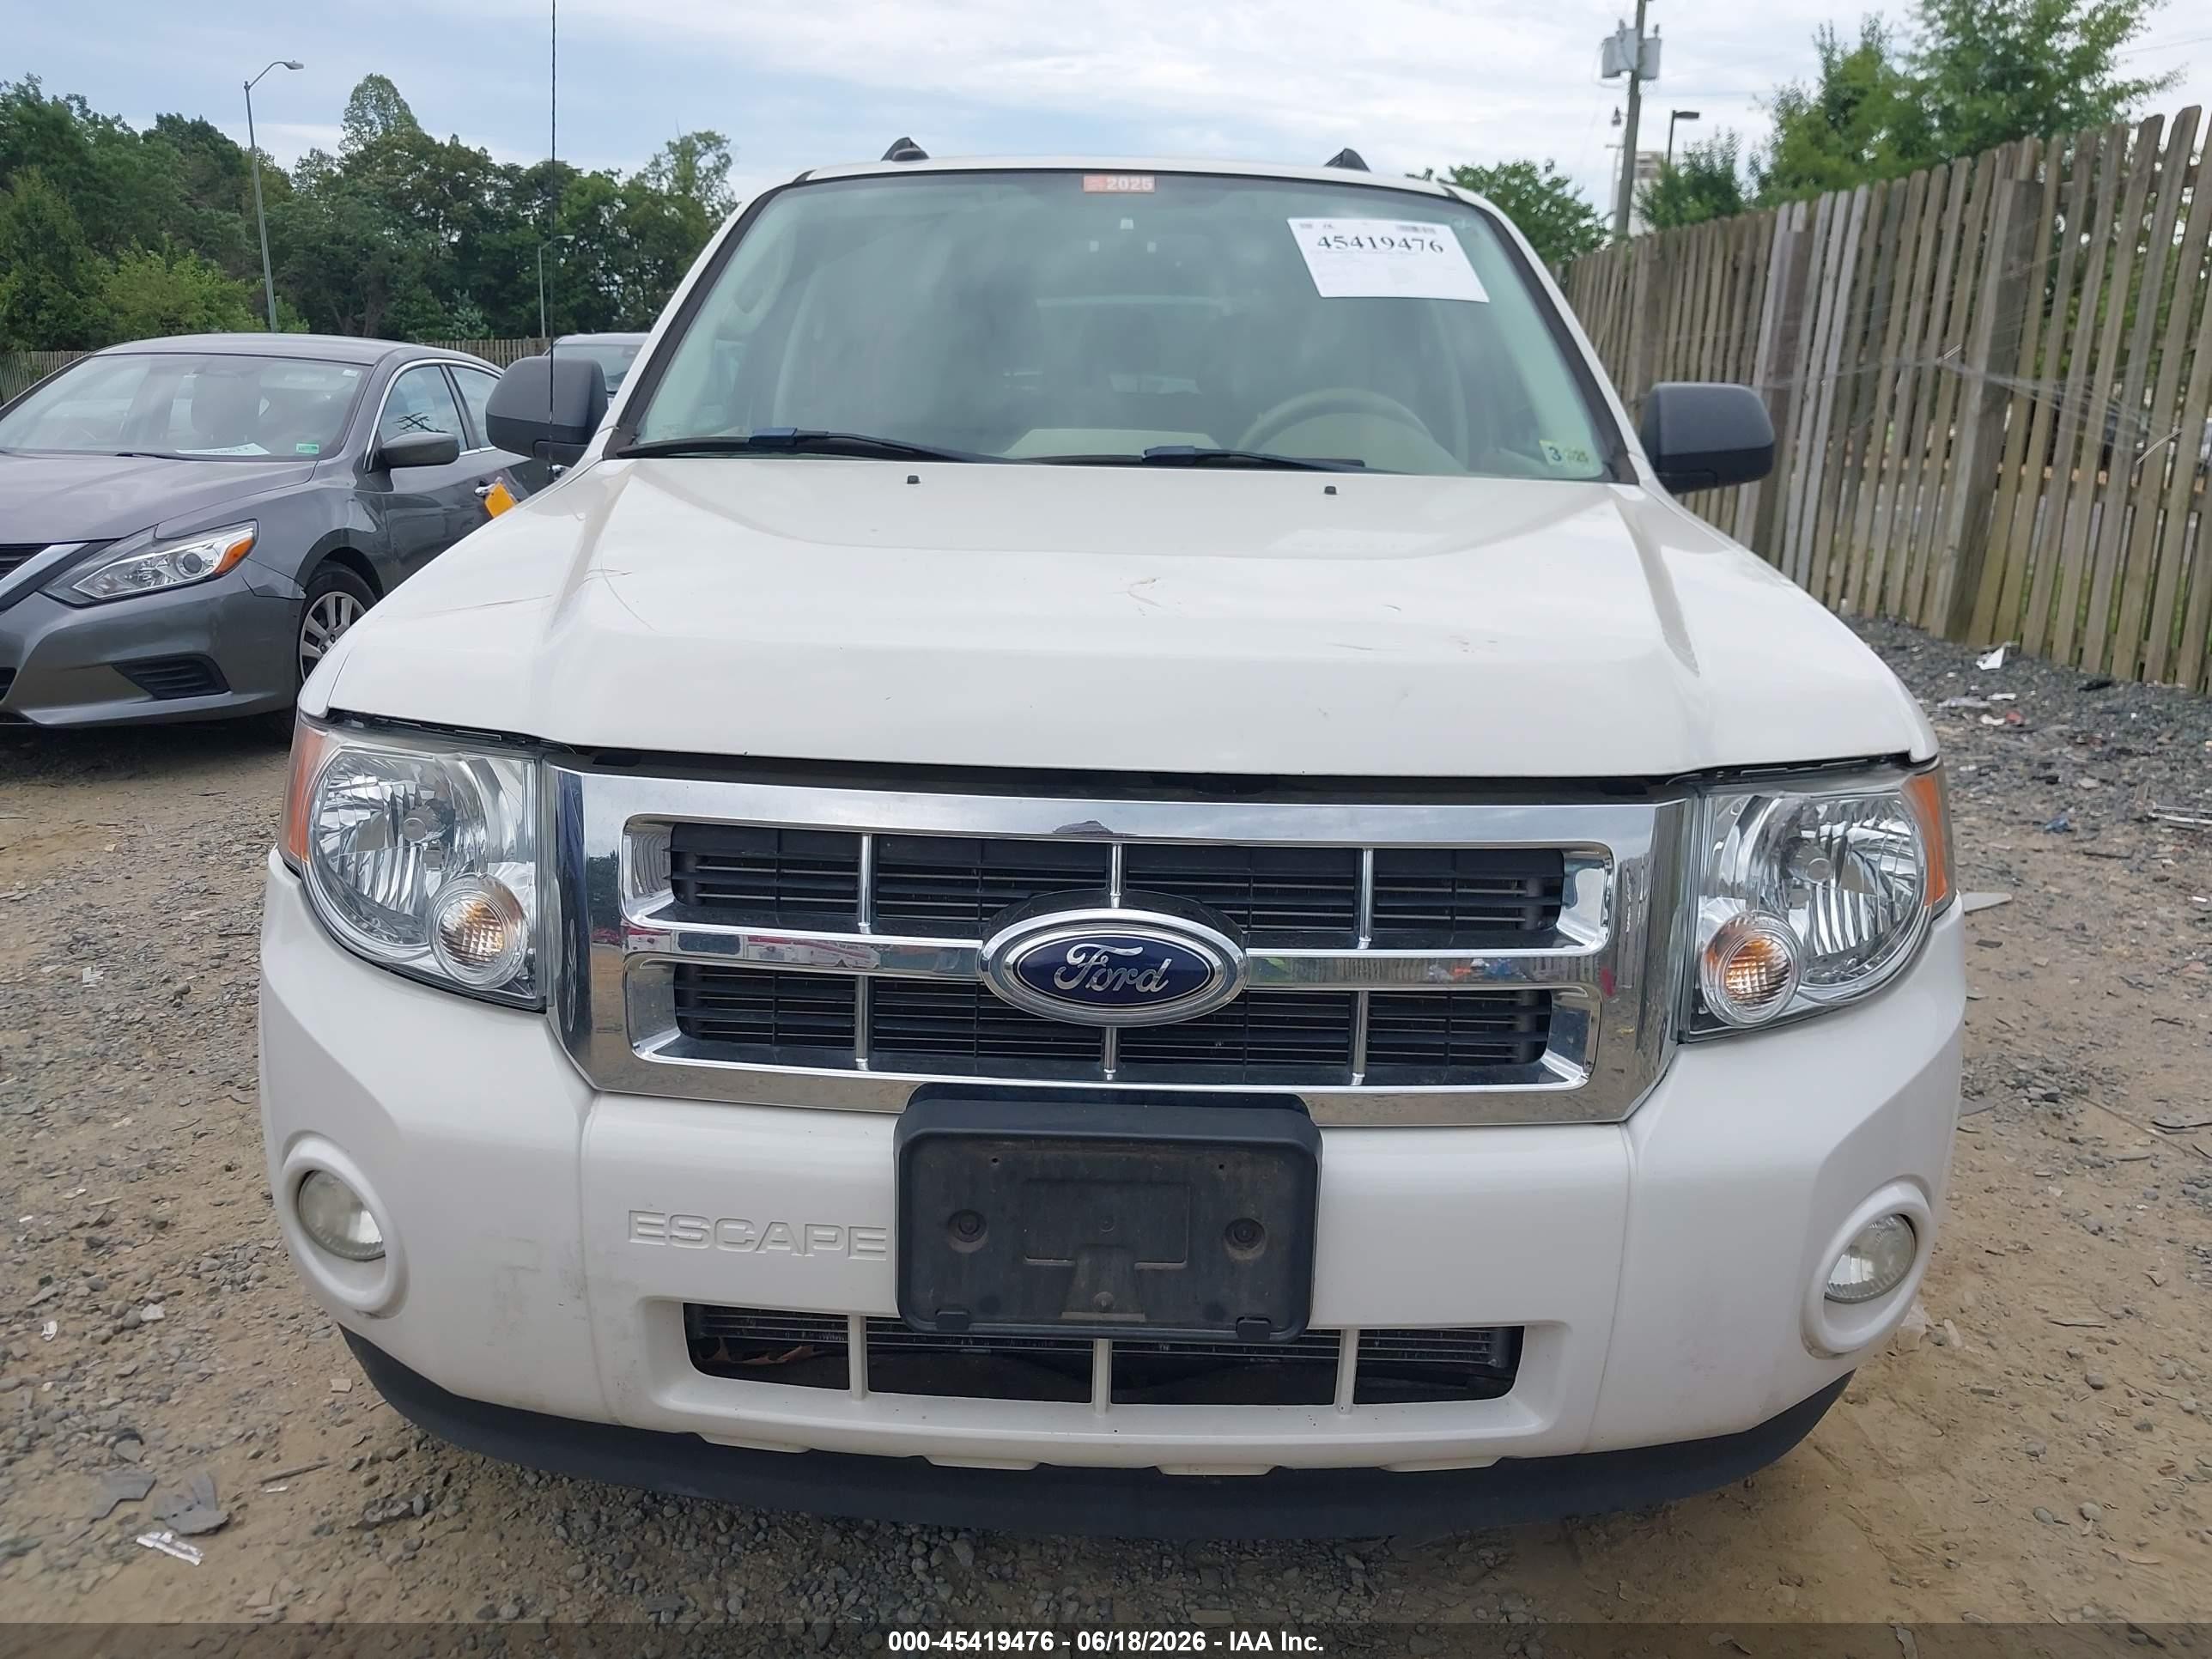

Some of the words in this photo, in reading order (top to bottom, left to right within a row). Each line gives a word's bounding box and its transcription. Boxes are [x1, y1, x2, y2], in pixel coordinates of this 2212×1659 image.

[1316, 234, 1444, 254] 45419476
[1054, 943, 1171, 993] Ford
[628, 1209, 887, 1261] ESCAPE
